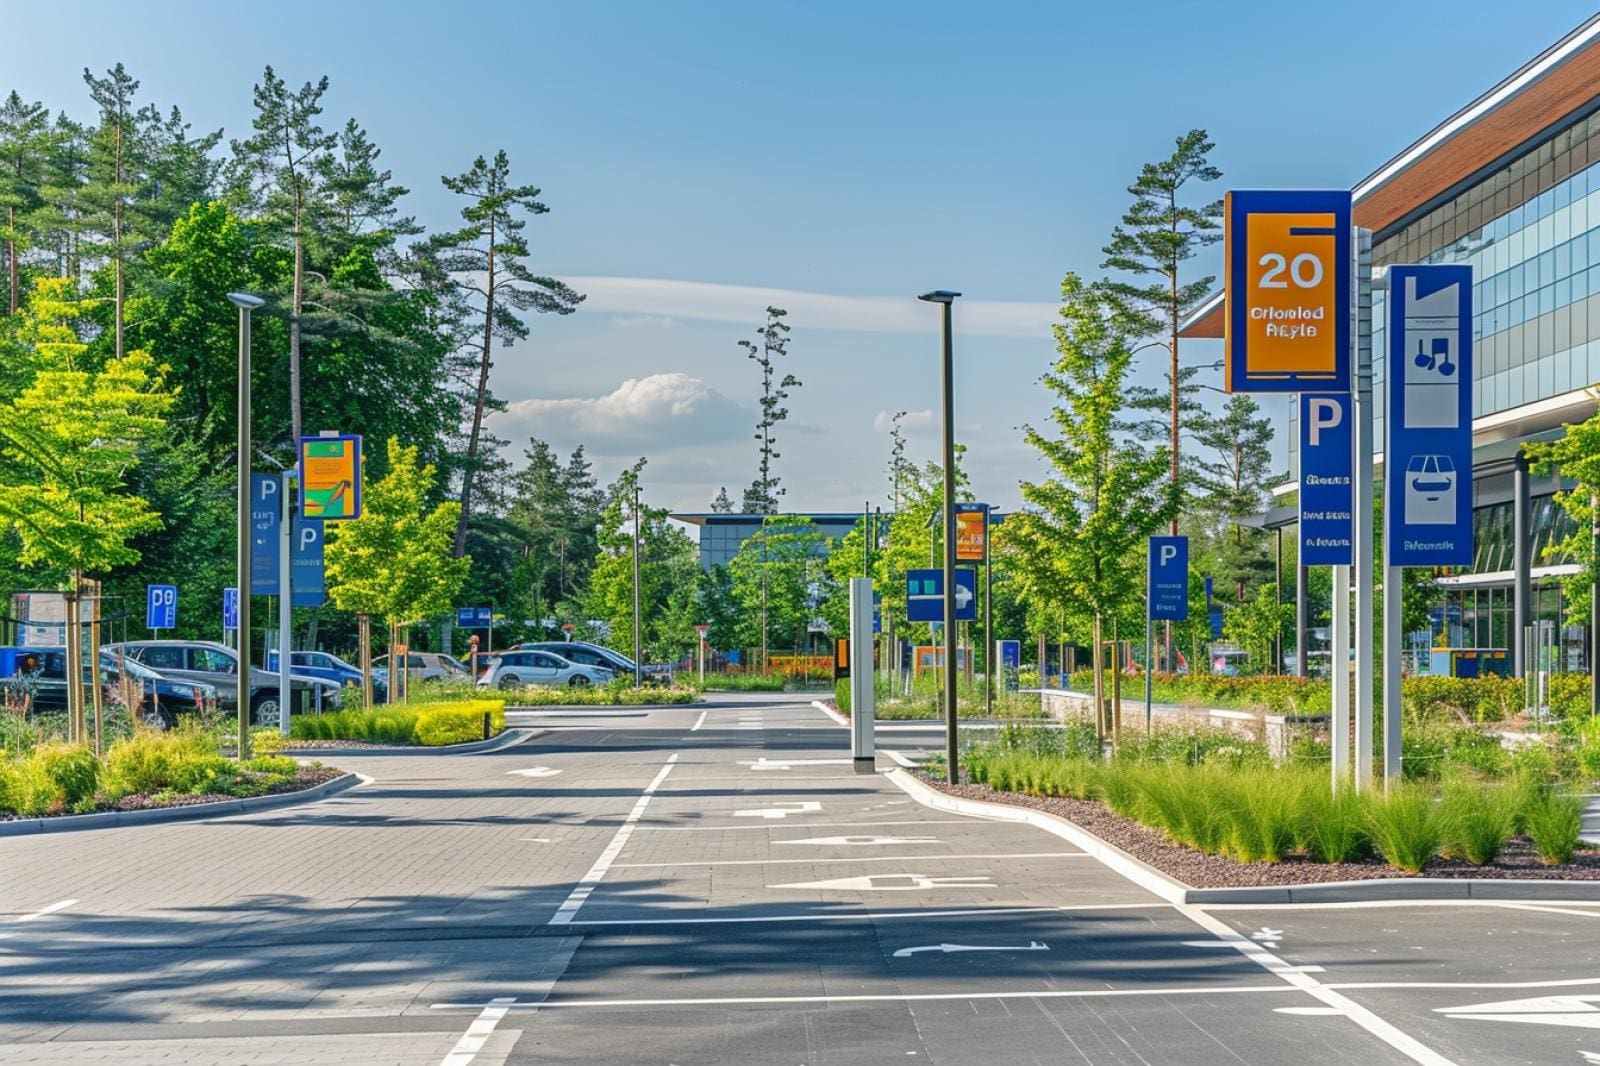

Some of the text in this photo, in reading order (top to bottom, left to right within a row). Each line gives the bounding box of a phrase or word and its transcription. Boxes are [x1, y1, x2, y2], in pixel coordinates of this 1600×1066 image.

[1258, 253, 1324, 288] 20
[1309, 398, 1343, 446] P
[261, 480, 277, 500] P
[300, 527, 317, 551] P
[1160, 545, 1177, 566] P
